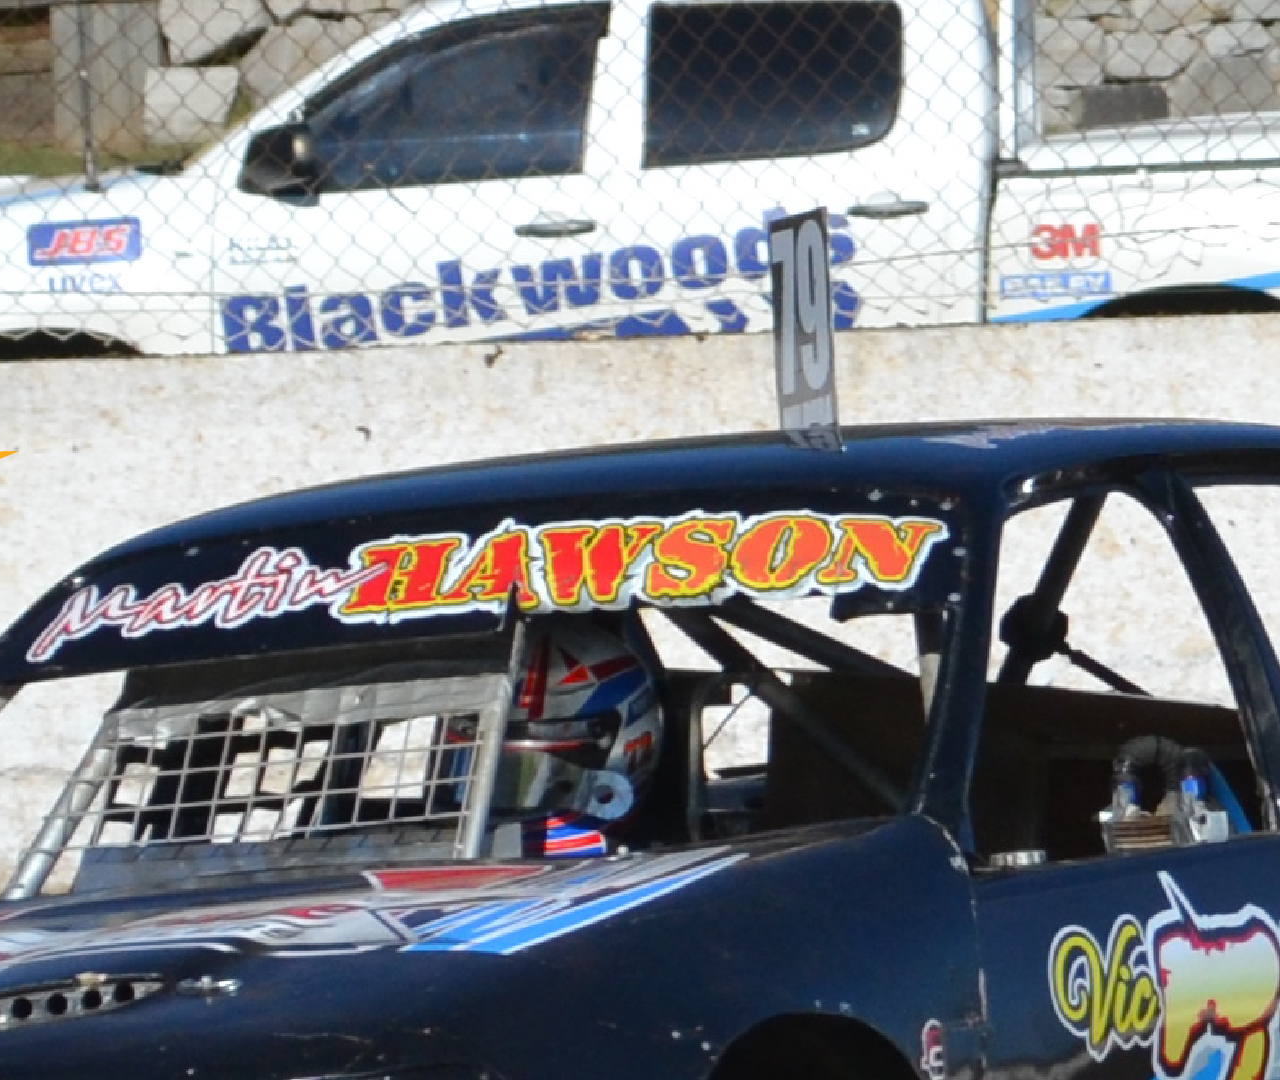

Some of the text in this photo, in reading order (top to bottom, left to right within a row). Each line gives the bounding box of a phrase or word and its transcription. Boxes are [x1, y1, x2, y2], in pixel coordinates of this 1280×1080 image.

[1032, 223, 1100, 260] 3M
[337, 513, 944, 622] HAWSON
[1051, 914, 1161, 1060] Vic
